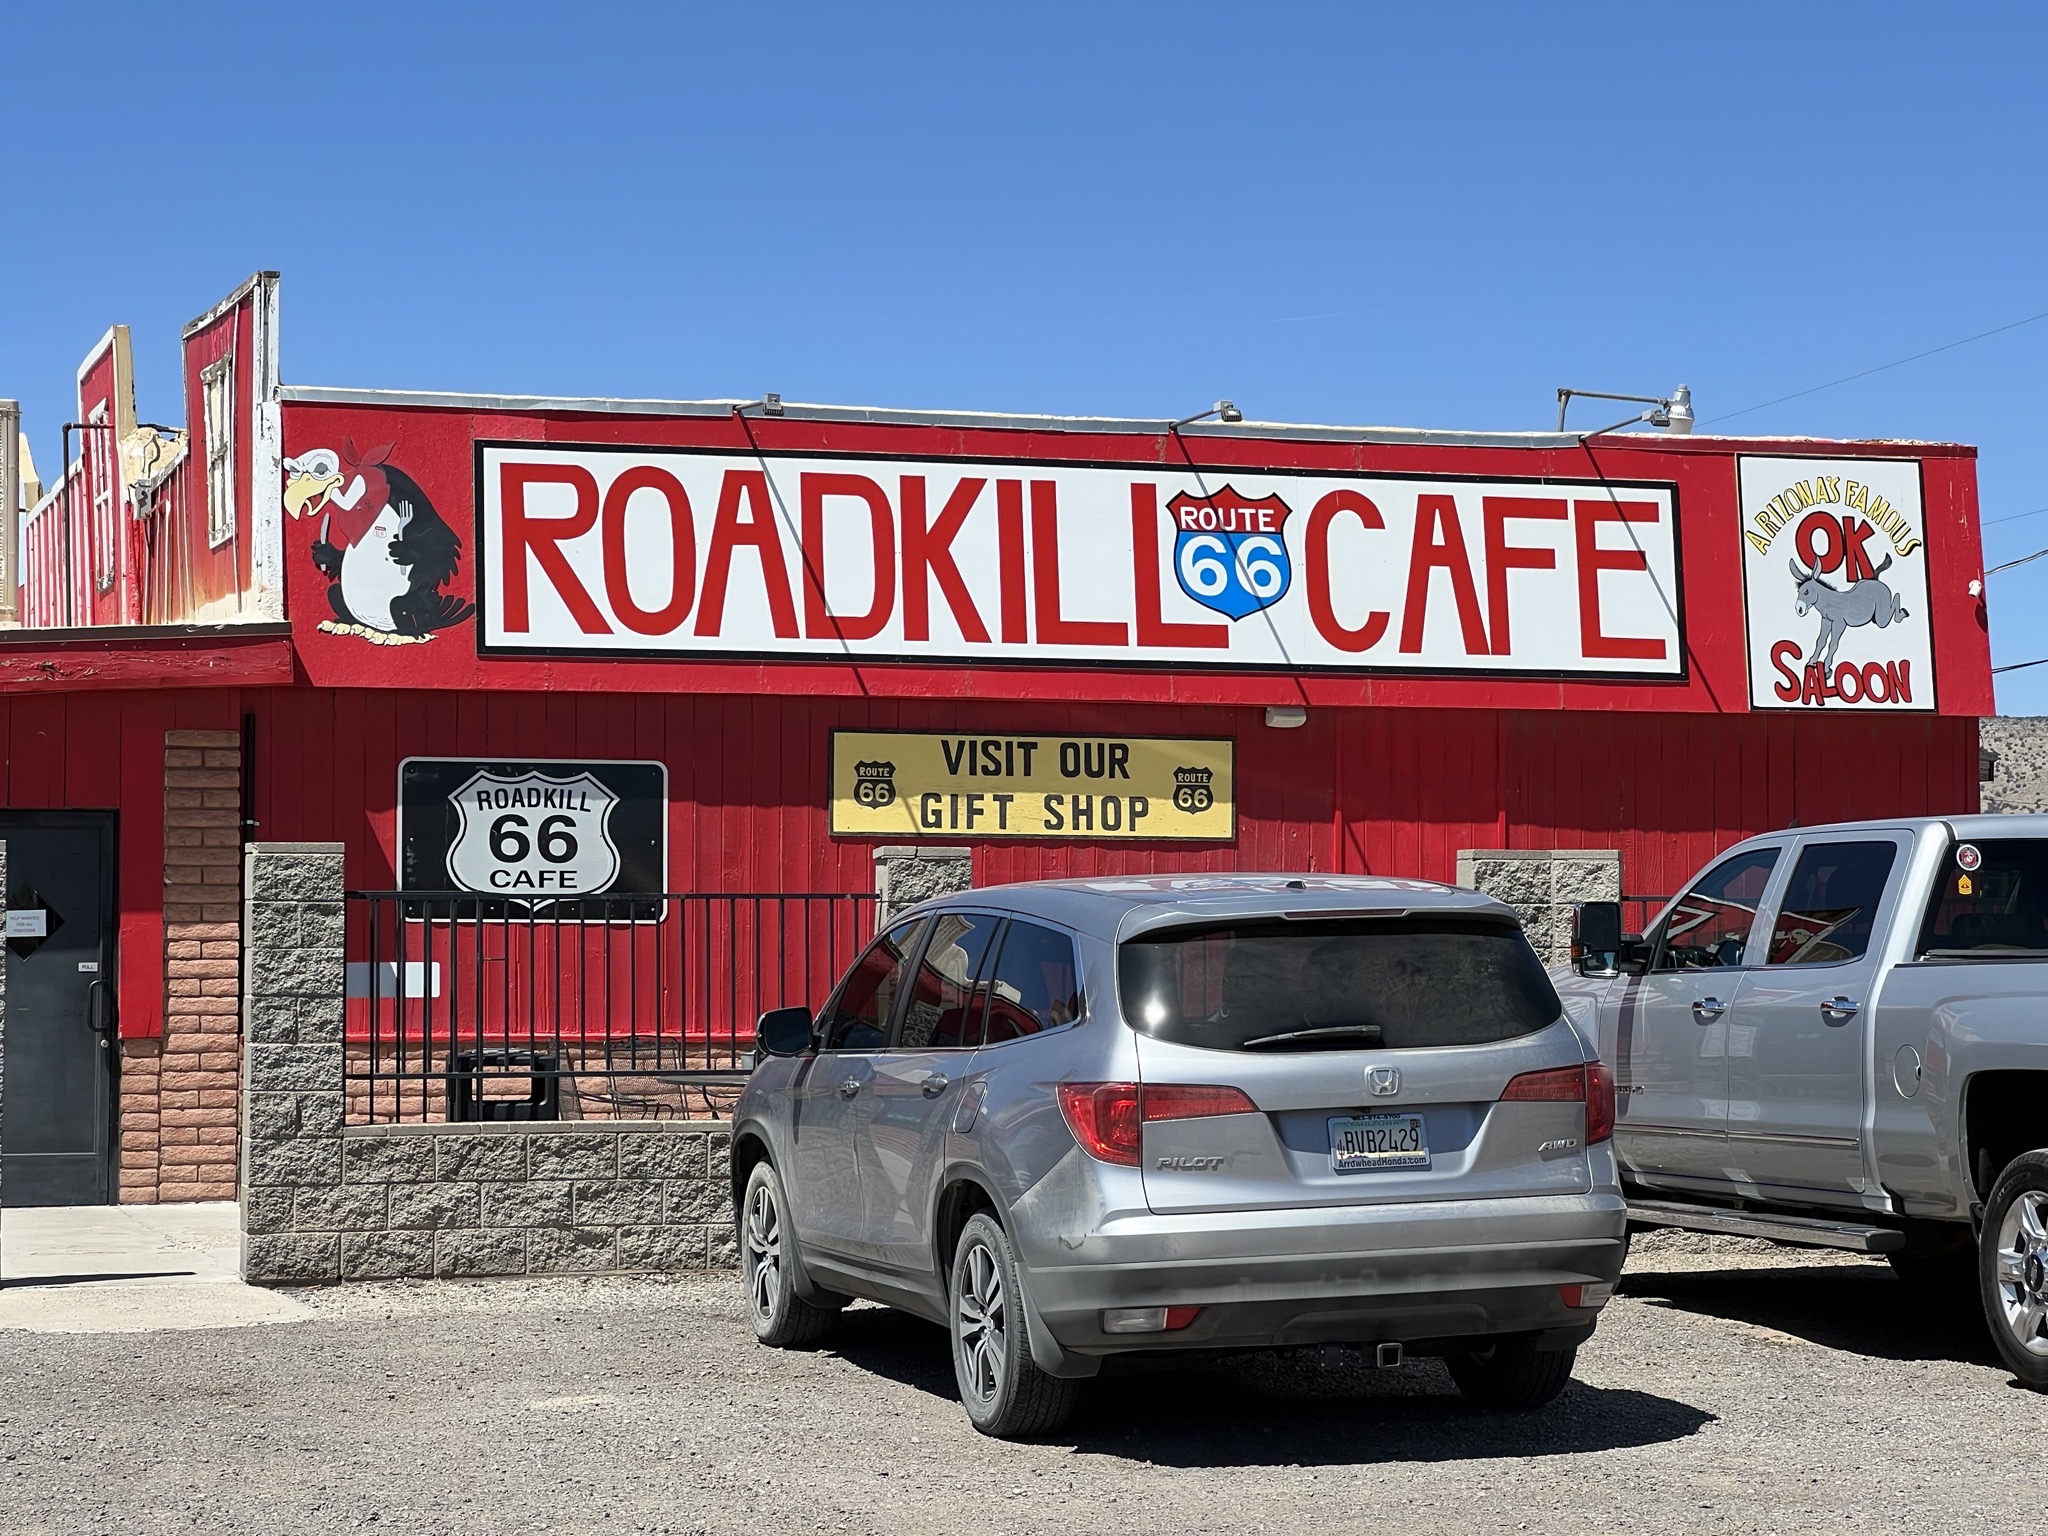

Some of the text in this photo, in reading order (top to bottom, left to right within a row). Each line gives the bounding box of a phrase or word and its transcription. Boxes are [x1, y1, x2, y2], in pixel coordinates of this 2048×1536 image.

[1180, 505, 1276, 532] ROUTE
[1745, 476, 1922, 556] ARIZONA'S FAMOUS
[1795, 511, 1875, 582] OK
[500, 462, 1667, 660] ROADKILL CAFE
[1180, 536, 1283, 598] 66
[1770, 640, 1912, 706] SALOON
[859, 766, 891, 778] ROUTE
[941, 739, 1131, 779] VISIT OUR
[1177, 772, 1209, 783] ROUTE
[476, 788, 592, 812] ROADKILL
[858, 783, 891, 802] 66
[1177, 787, 1209, 807] 66
[921, 792, 1149, 831] GIFT SHOP
[489, 814, 579, 864] 66
[489, 870, 579, 889] CAFE
[1344, 1128, 1419, 1155] BVB2429
[1538, 1139, 1577, 1151] AWD
[1157, 1157, 1224, 1170] PILOT
[1339, 1157, 1427, 1169] ArrowheadHonda.com
